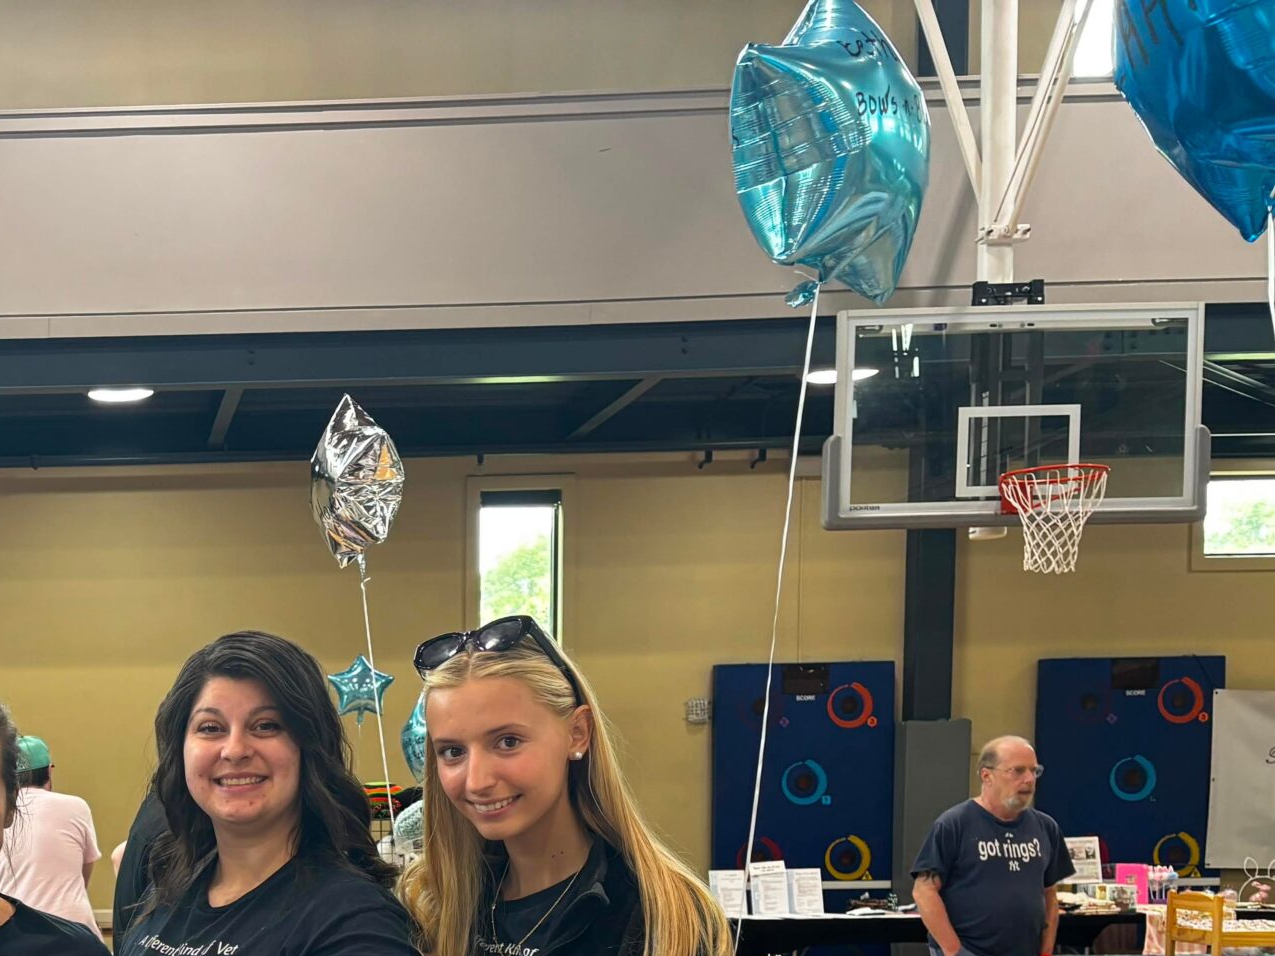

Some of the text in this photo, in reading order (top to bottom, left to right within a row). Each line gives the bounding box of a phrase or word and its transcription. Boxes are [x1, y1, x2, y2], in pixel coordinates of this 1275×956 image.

[978, 838, 1002, 861] got
[1002, 838, 1042, 863] rings?
[216, 941, 239, 956] Vet
